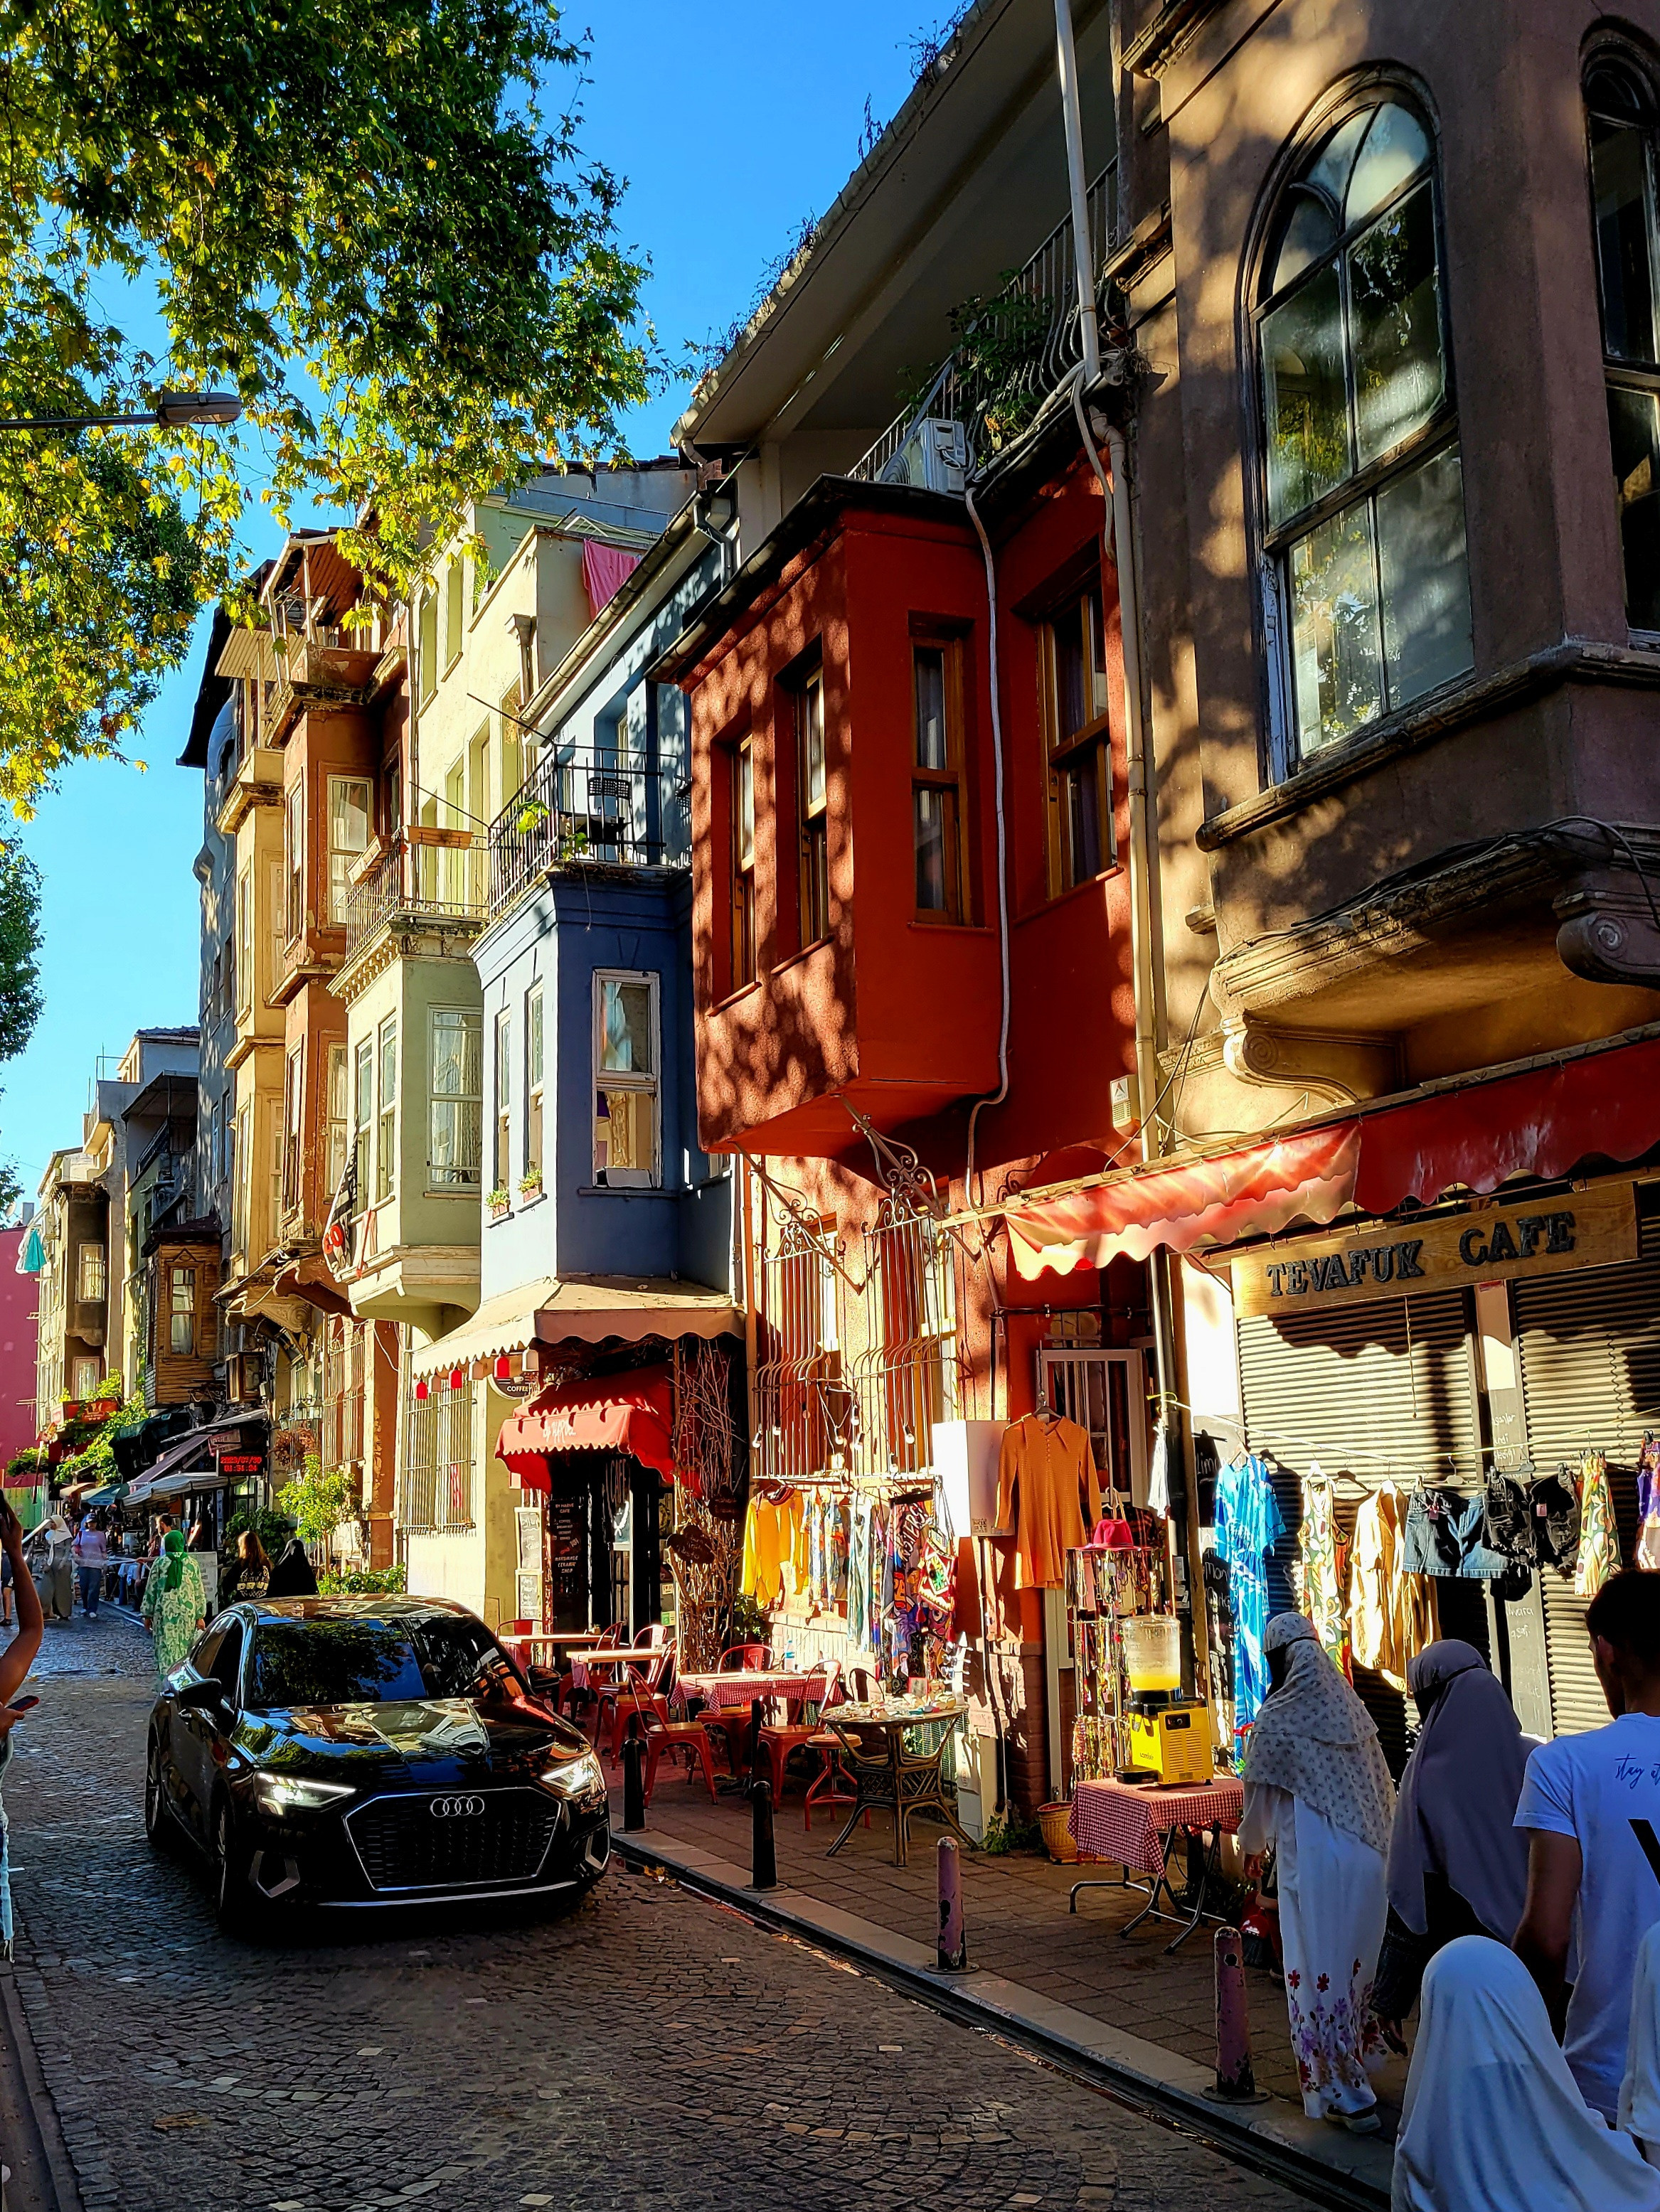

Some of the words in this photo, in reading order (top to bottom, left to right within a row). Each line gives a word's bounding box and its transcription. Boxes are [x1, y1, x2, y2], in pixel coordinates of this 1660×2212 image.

[1266, 1239, 1425, 1296] TEVAFUK
[1459, 1211, 1575, 1266] CAFE
[1614, 1753, 1644, 1789] stay
